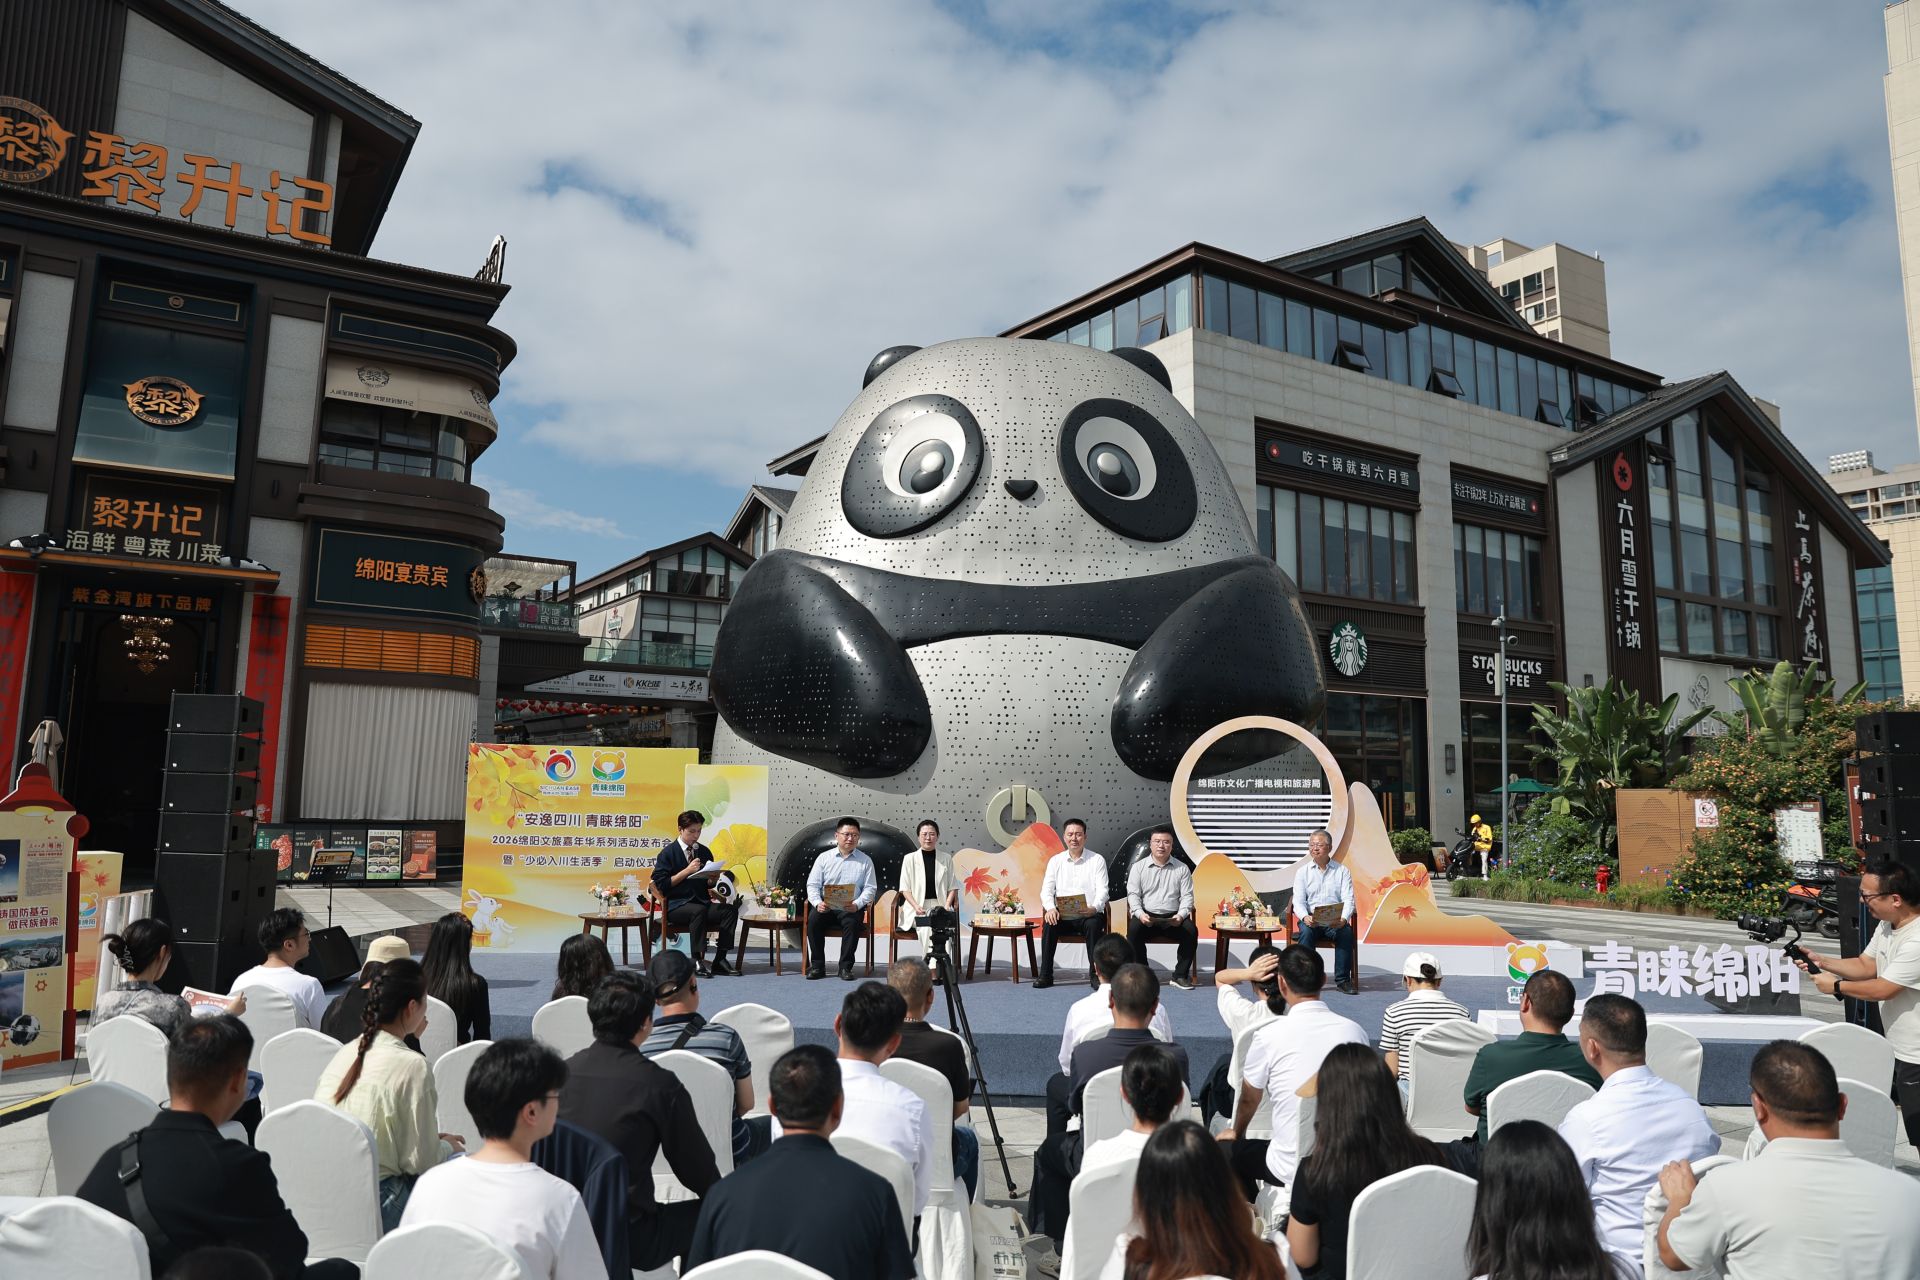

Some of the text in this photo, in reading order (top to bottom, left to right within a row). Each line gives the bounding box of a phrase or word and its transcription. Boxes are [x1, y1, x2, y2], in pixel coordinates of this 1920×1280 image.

[81, 130, 333, 245] 黎升记
[1302, 450, 1410, 486] 吃干锅就到六月雪
[92, 495, 203, 537] 黎升记
[65, 529, 222, 564] 海鲜 粤菜 川菜
[355, 556, 449, 589] 绵阳宴贵宾
[1617, 499, 1642, 649] 六月雪干锅
[1472, 655, 1542, 675] STABUCKS
[1486, 671, 1530, 688] CFEE
[592, 783, 625, 792] 青睐绵阳
[1198, 778, 1321, 789] 绵阳市文化广播电视和旅游局
[492, 835, 674, 848] 2026绵阳文旅嘉年华系列活动发布会
[503, 854, 514, 866] 暨
[613, 857, 657, 868] 启动仪式
[8, 917, 59, 930] 做民族脊梁
[1585, 940, 1801, 1003] 青睐绵阳
